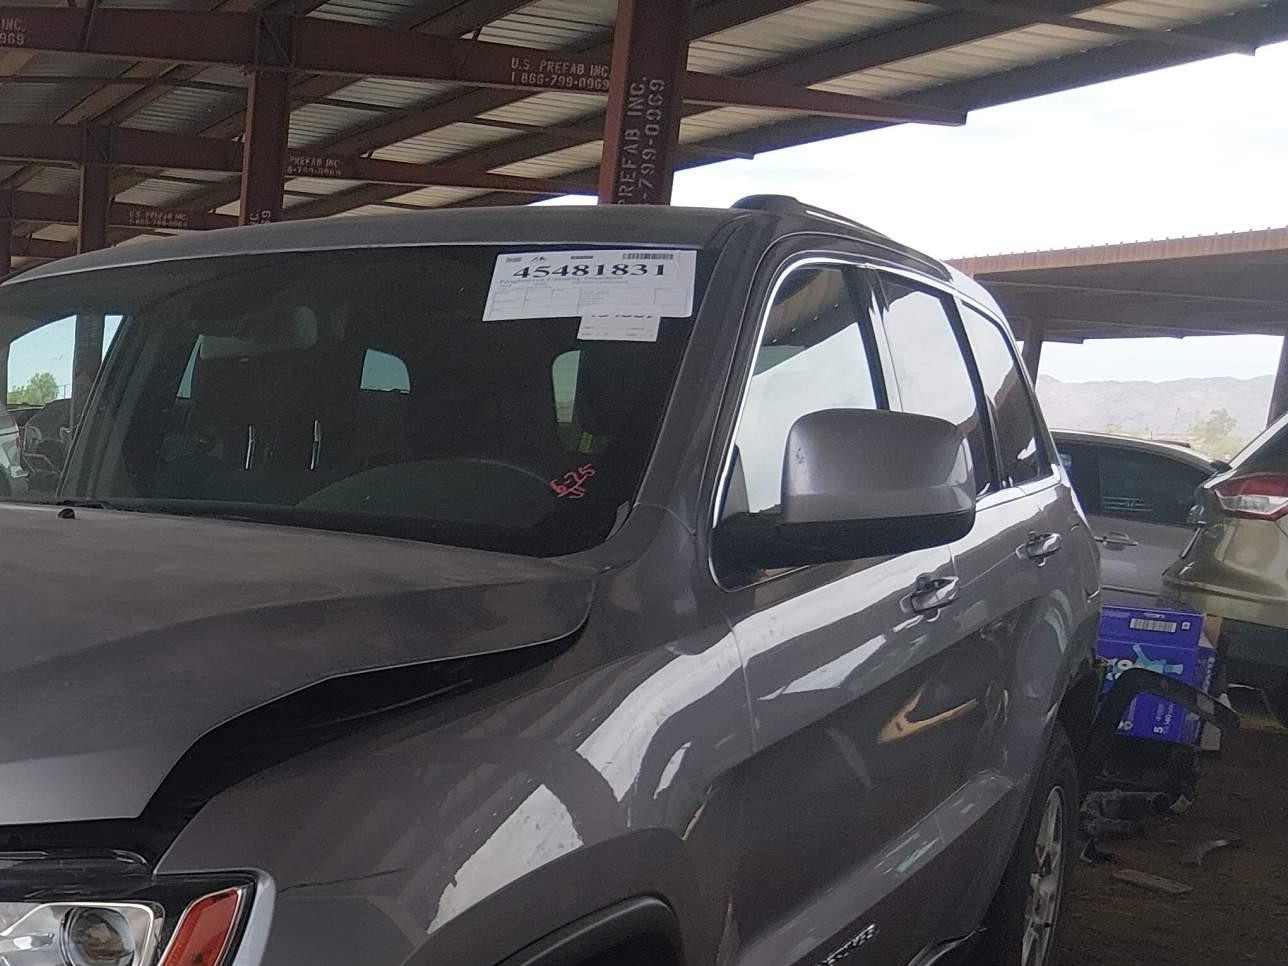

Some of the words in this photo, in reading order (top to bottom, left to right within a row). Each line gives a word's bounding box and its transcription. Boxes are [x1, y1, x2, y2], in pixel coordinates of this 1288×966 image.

[1, 18, 26, 33] INC.
[539, 60, 586, 75] PREFAB
[626, 76, 647, 117] INC.
[638, 79, 665, 204] -799-0969
[513, 264, 665, 278] 45481831
